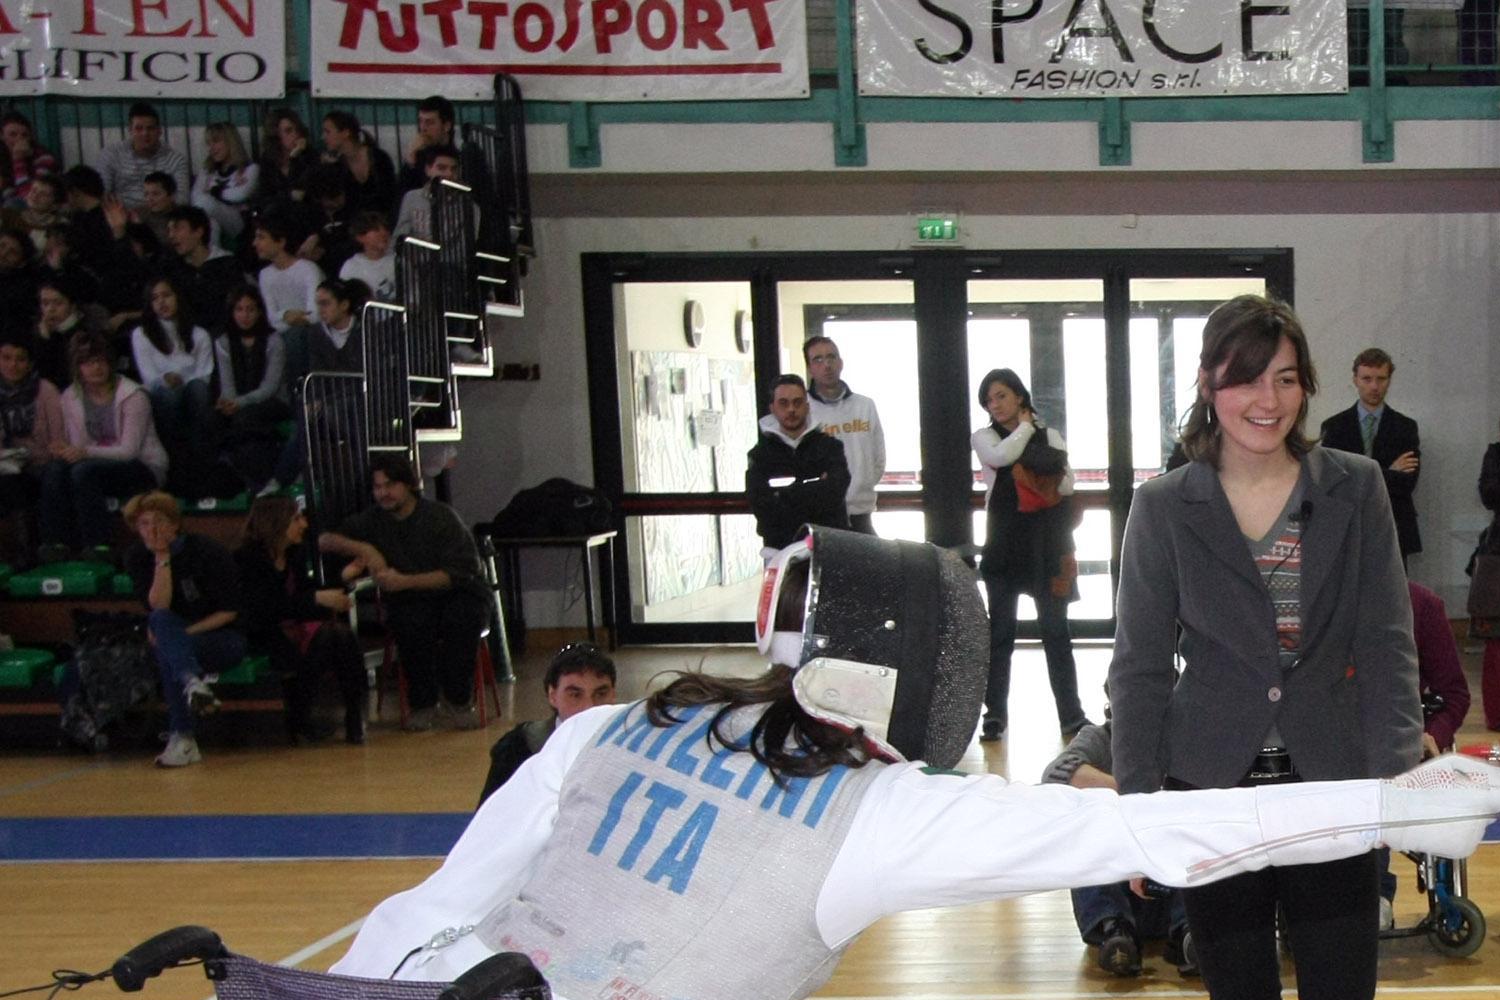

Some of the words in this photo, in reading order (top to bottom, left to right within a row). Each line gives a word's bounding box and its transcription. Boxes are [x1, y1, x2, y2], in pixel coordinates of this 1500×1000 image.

[0, 0, 255, 37] -TEN
[331, 0, 778, 54] TUTTOSPORT
[914, 0, 1292, 64] SPACE
[1010, 69, 1141, 91] FASHION
[587, 771, 719, 896] ITA
